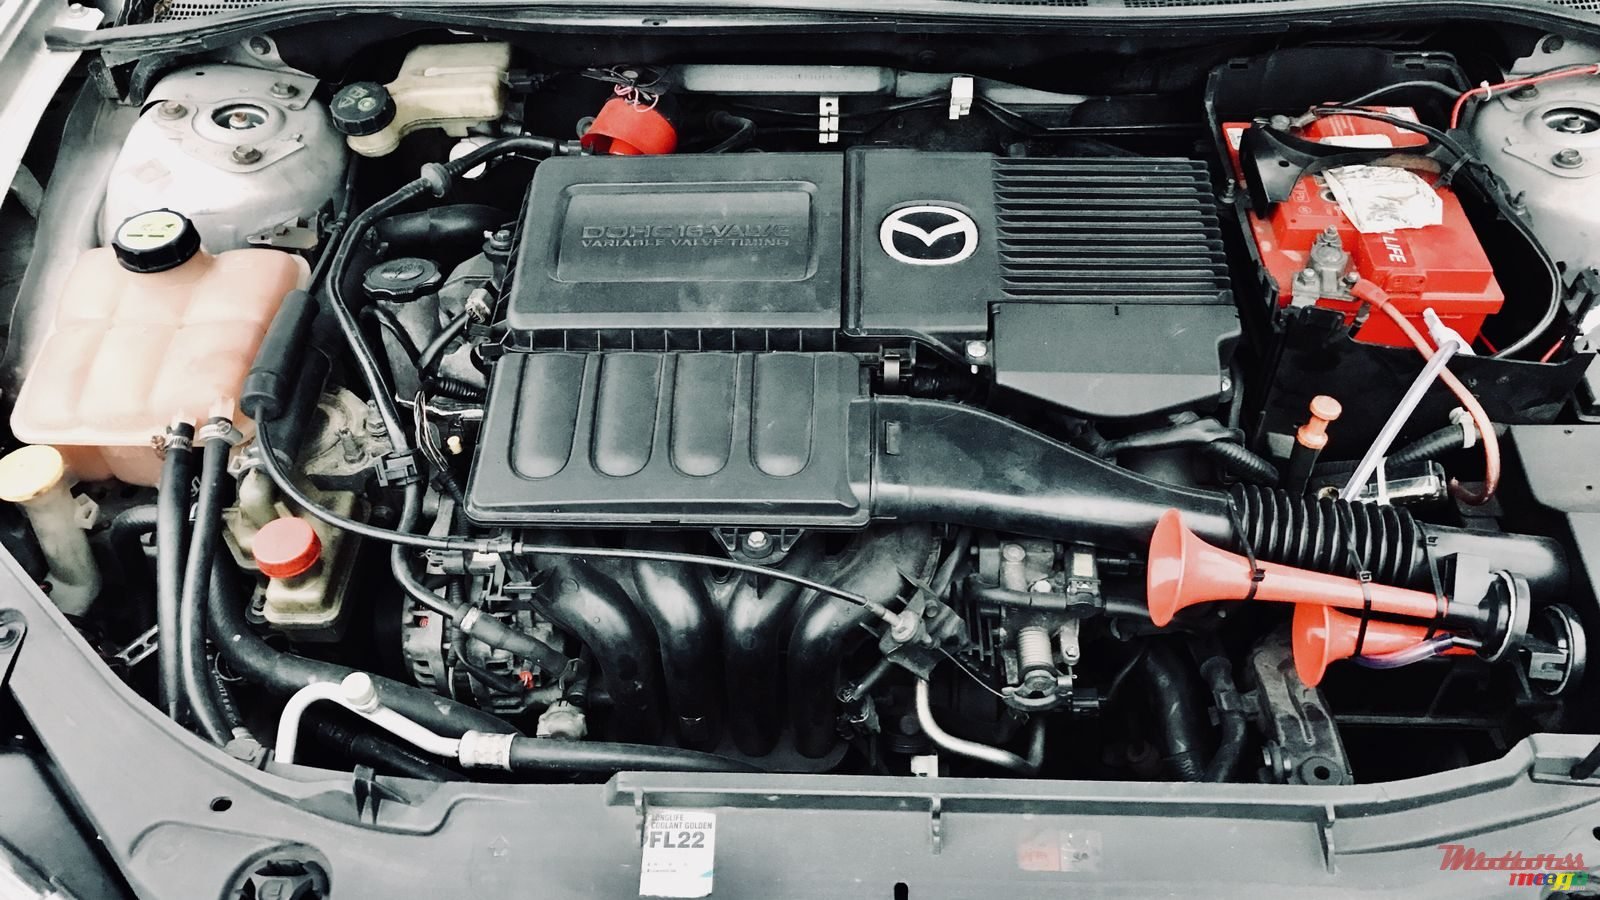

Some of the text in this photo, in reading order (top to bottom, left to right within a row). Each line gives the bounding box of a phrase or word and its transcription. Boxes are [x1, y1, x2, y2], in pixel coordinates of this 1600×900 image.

[582, 223, 791, 239] DOHC 16-VALVE
[582, 237, 790, 248] VARIABLE VALVE TIMING
[1382, 236, 1407, 264] LIFE
[651, 821, 713, 830] COOLANT GOLDEN
[649, 831, 705, 849] FL22
